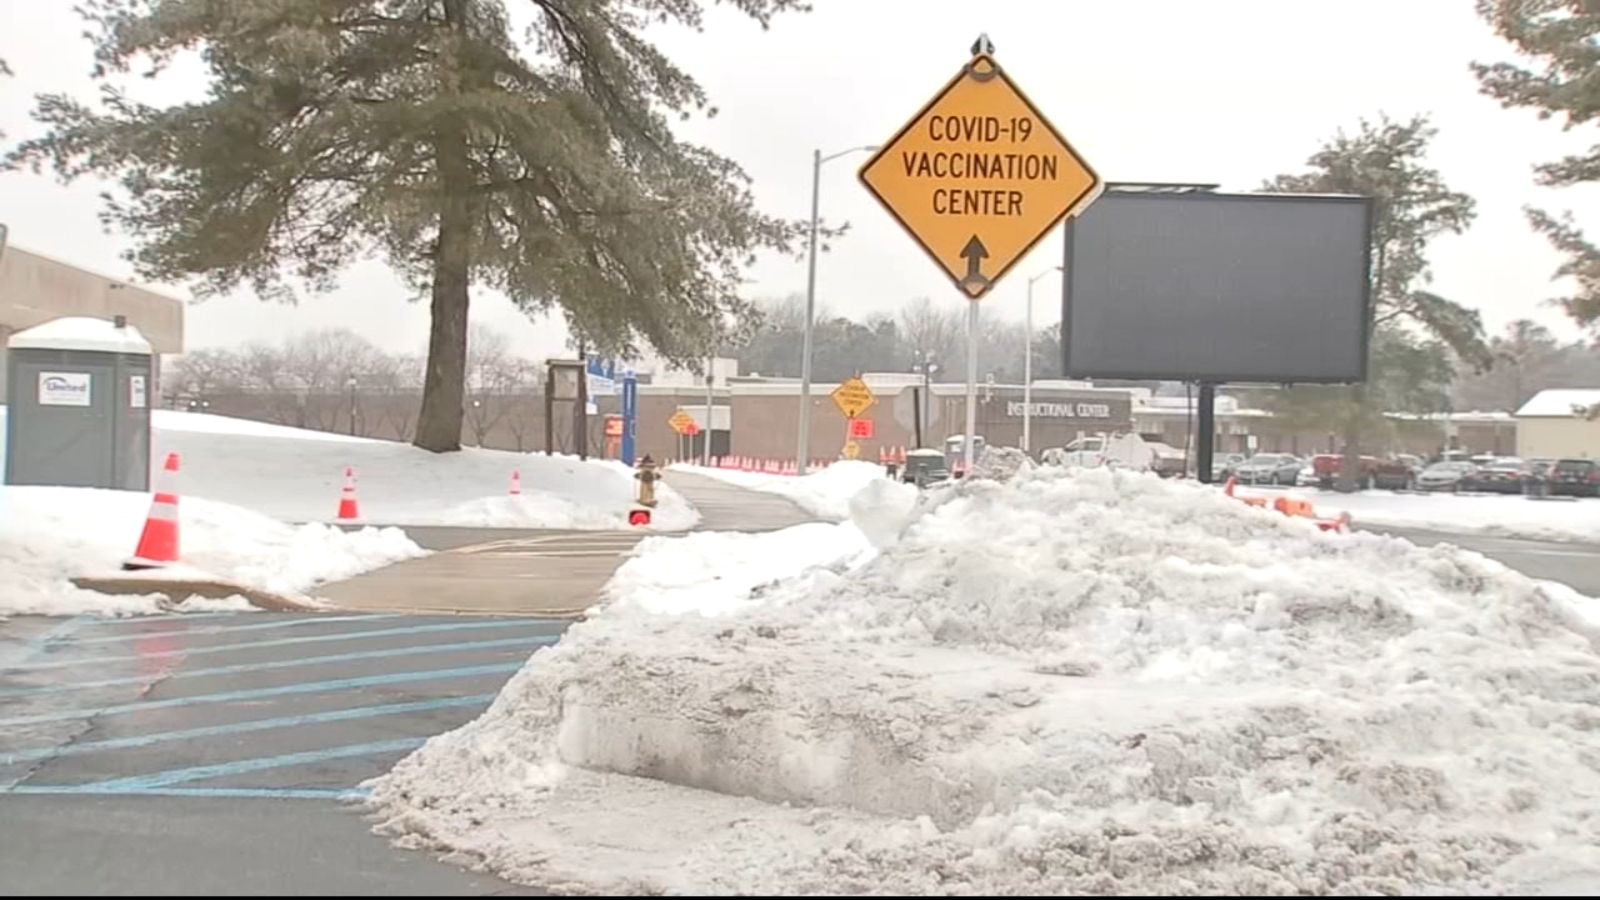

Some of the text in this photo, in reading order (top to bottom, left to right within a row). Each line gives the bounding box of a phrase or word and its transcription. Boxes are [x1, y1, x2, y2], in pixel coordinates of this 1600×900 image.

[929, 115, 1032, 143] COVID-19
[902, 151, 1058, 181] VACCINATION
[933, 188, 1023, 217] CENTER
[1077, 403, 1110, 418] CENTER
